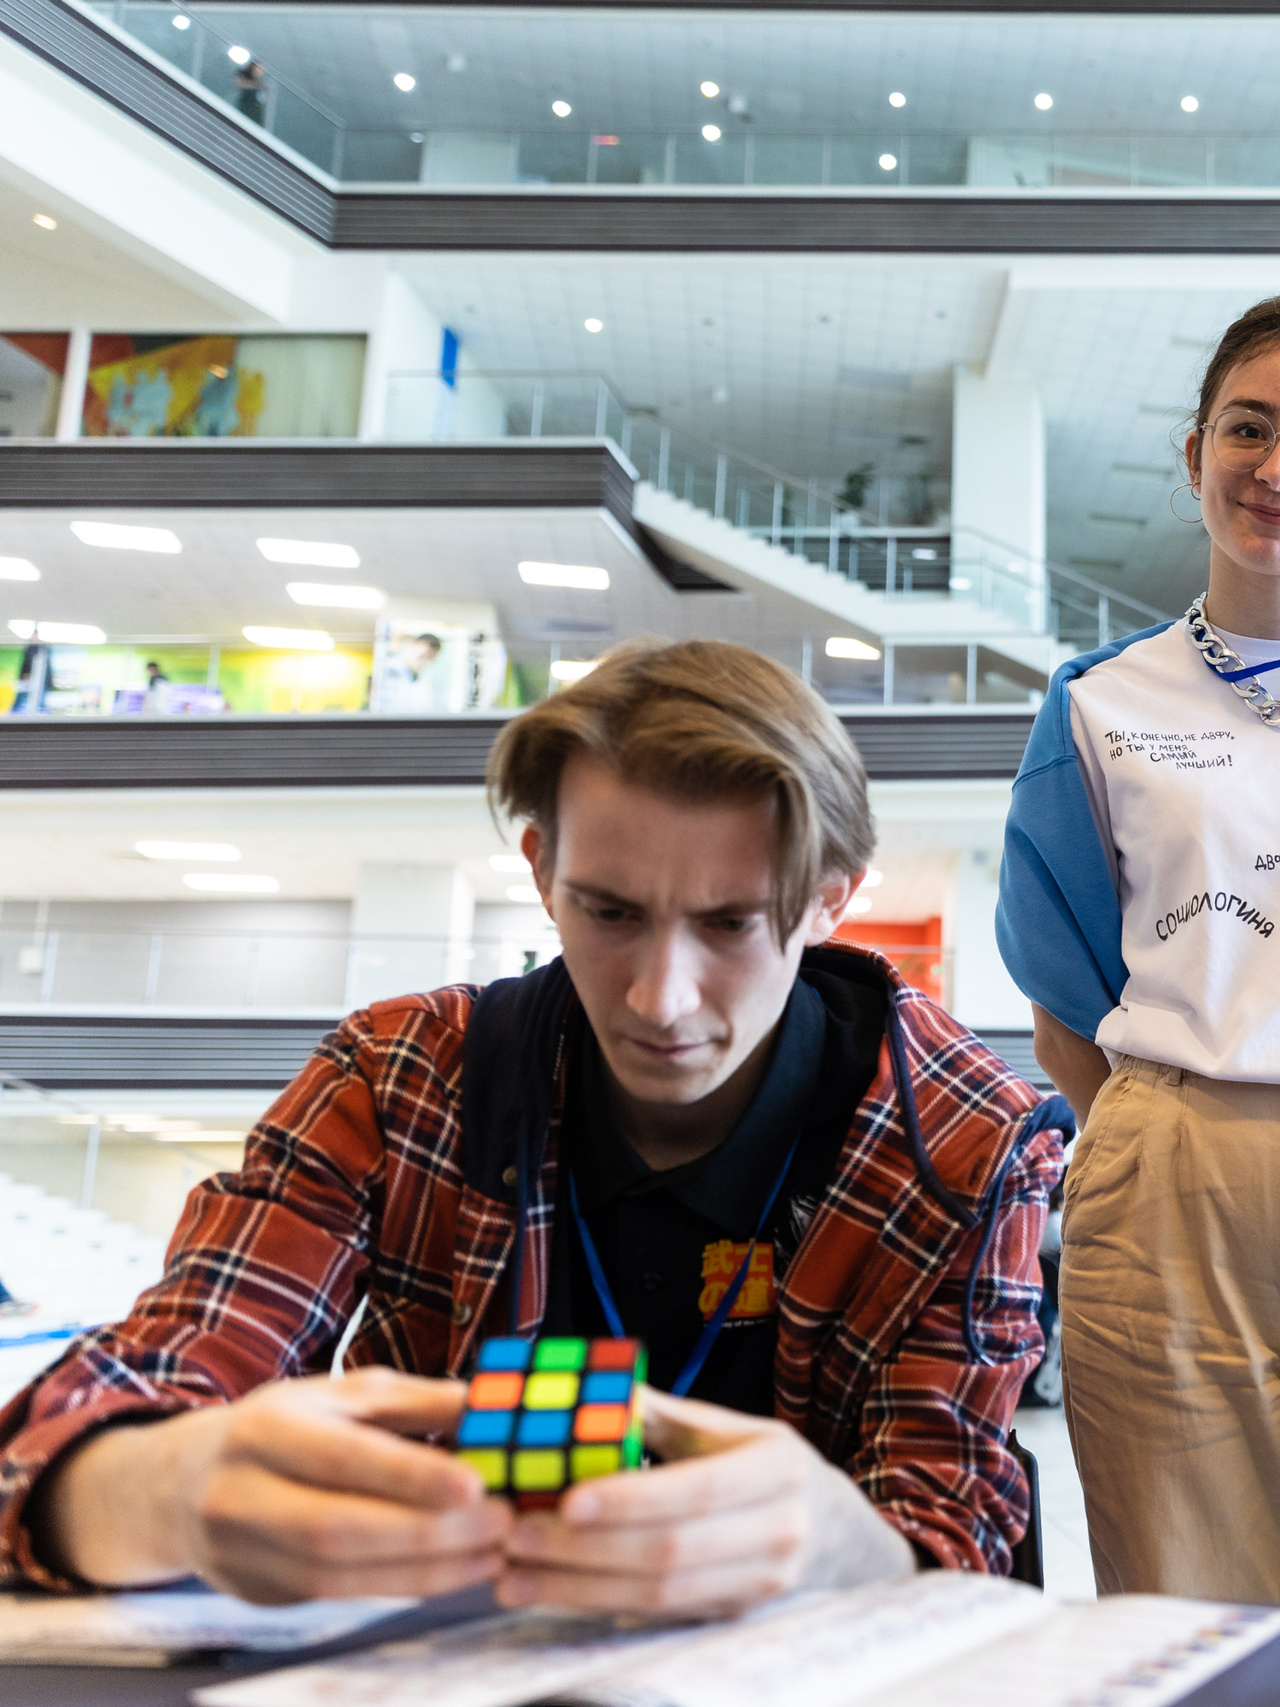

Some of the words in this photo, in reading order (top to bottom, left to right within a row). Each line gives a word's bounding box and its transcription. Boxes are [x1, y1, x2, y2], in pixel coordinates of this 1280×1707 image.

[1109, 746, 1123, 761] НО
[1159, 744, 1188, 752] МЕНЯ
[1155, 891, 1275, 941] СОЦИОЛОГИНЯ
